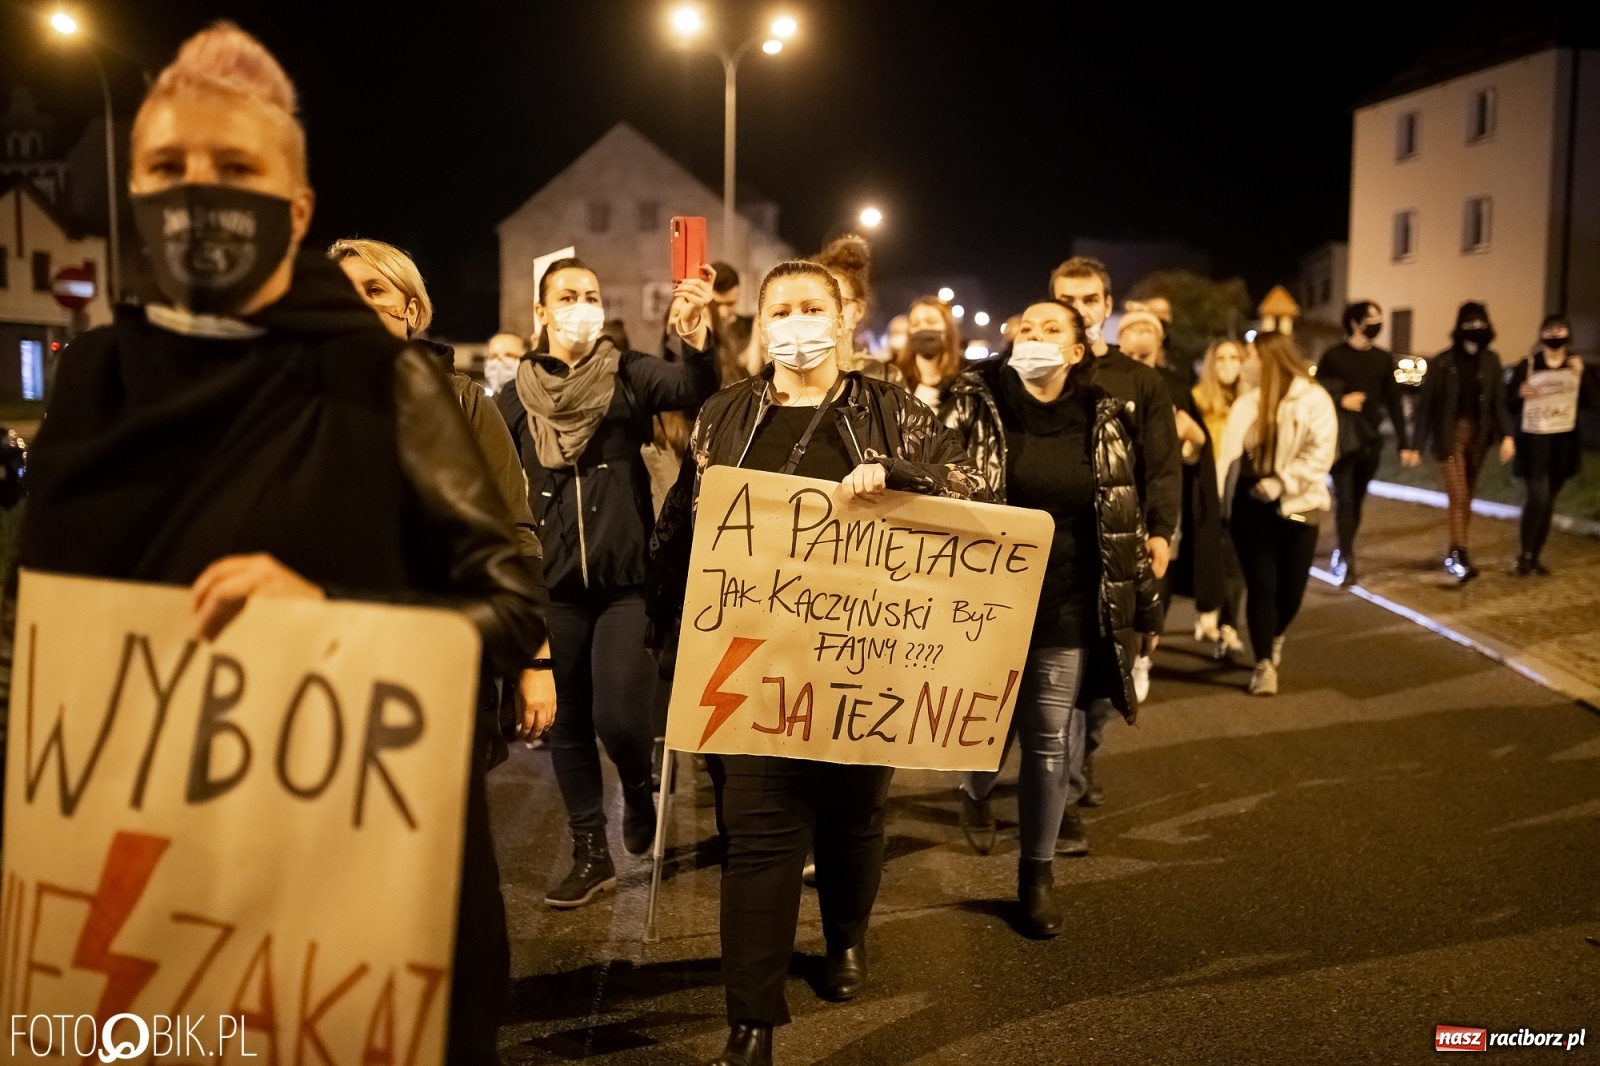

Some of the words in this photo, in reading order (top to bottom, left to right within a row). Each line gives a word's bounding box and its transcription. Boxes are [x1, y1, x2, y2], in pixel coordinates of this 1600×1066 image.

[712, 483, 755, 556] A
[904, 641, 945, 670] ????
[24, 624, 426, 830] WYBÓR
[751, 676, 813, 742] JA
[830, 682, 905, 743] TEŻ
[908, 670, 1019, 748] NIE!
